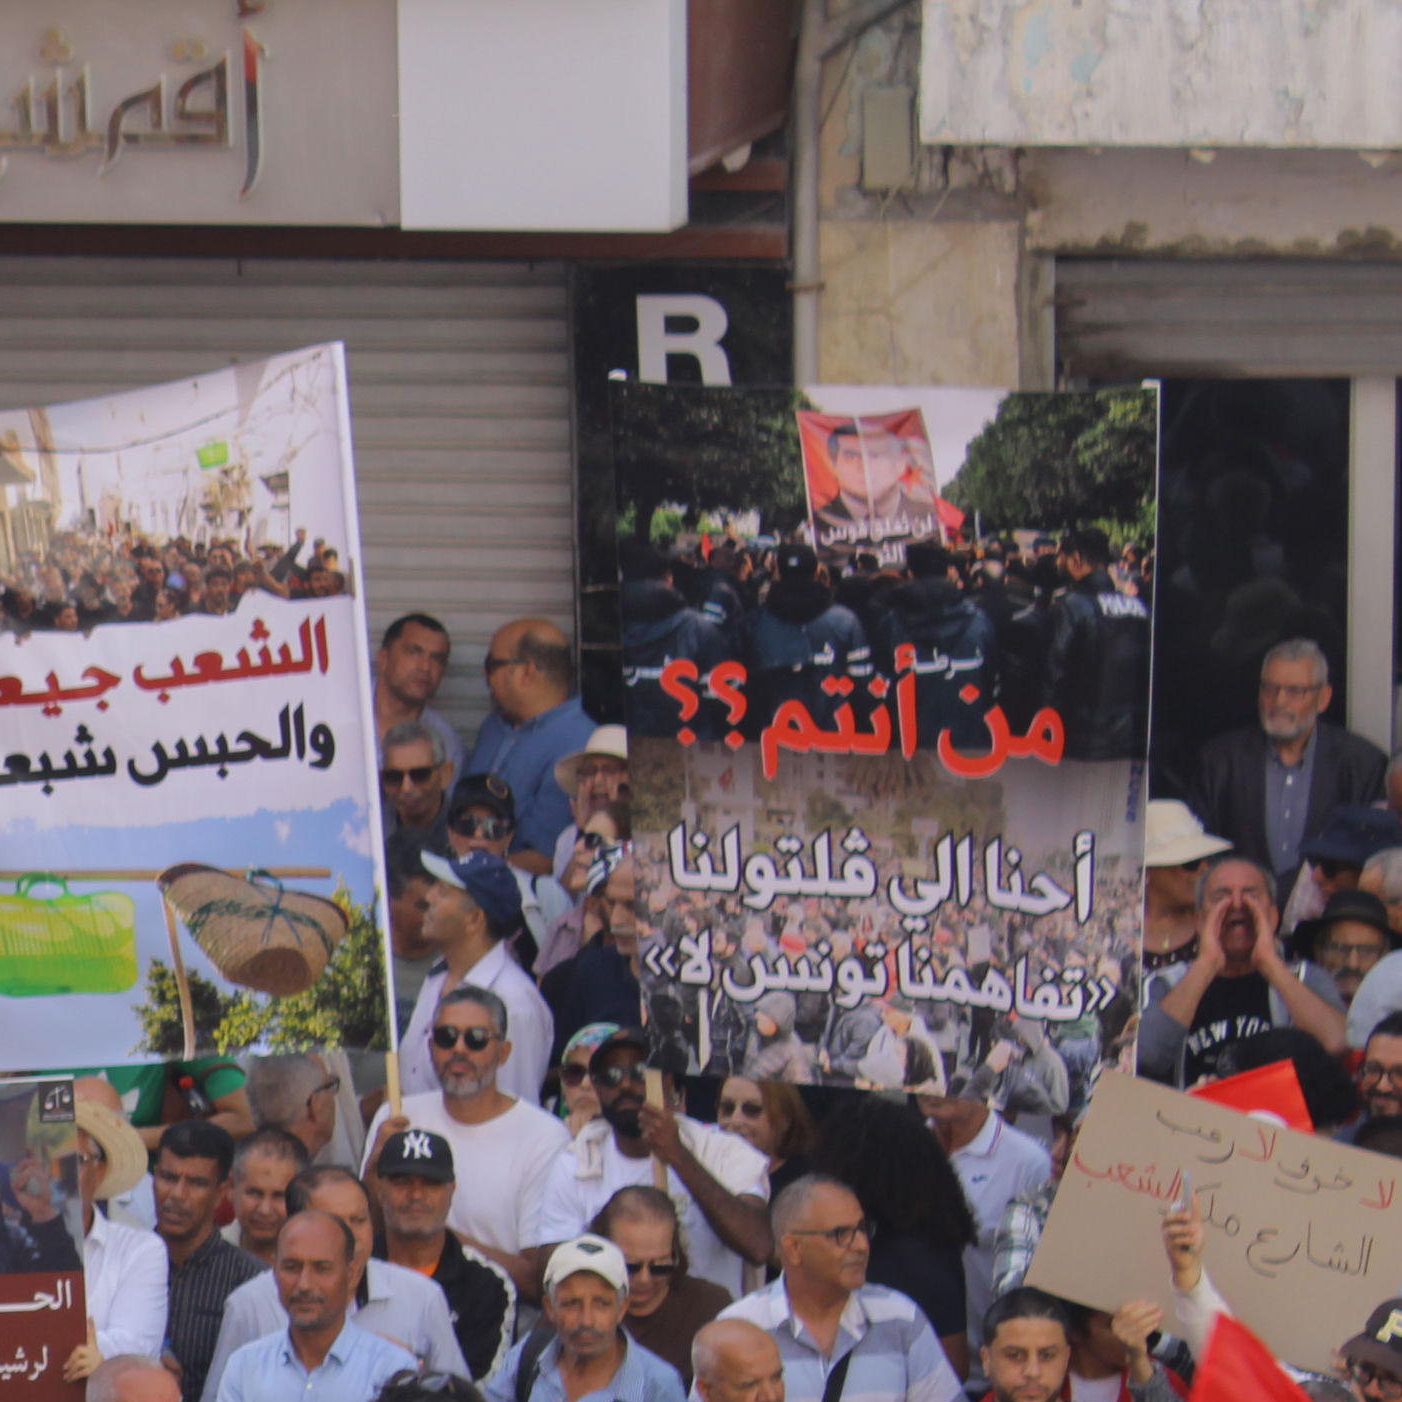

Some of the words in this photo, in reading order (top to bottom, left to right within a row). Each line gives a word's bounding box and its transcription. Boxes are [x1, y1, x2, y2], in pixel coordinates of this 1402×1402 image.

[132, 613, 330, 705] الشعب
[126, 700, 336, 788] والحبس
[936, 680, 1066, 780] من
[721, 944, 889, 1006] تونس
